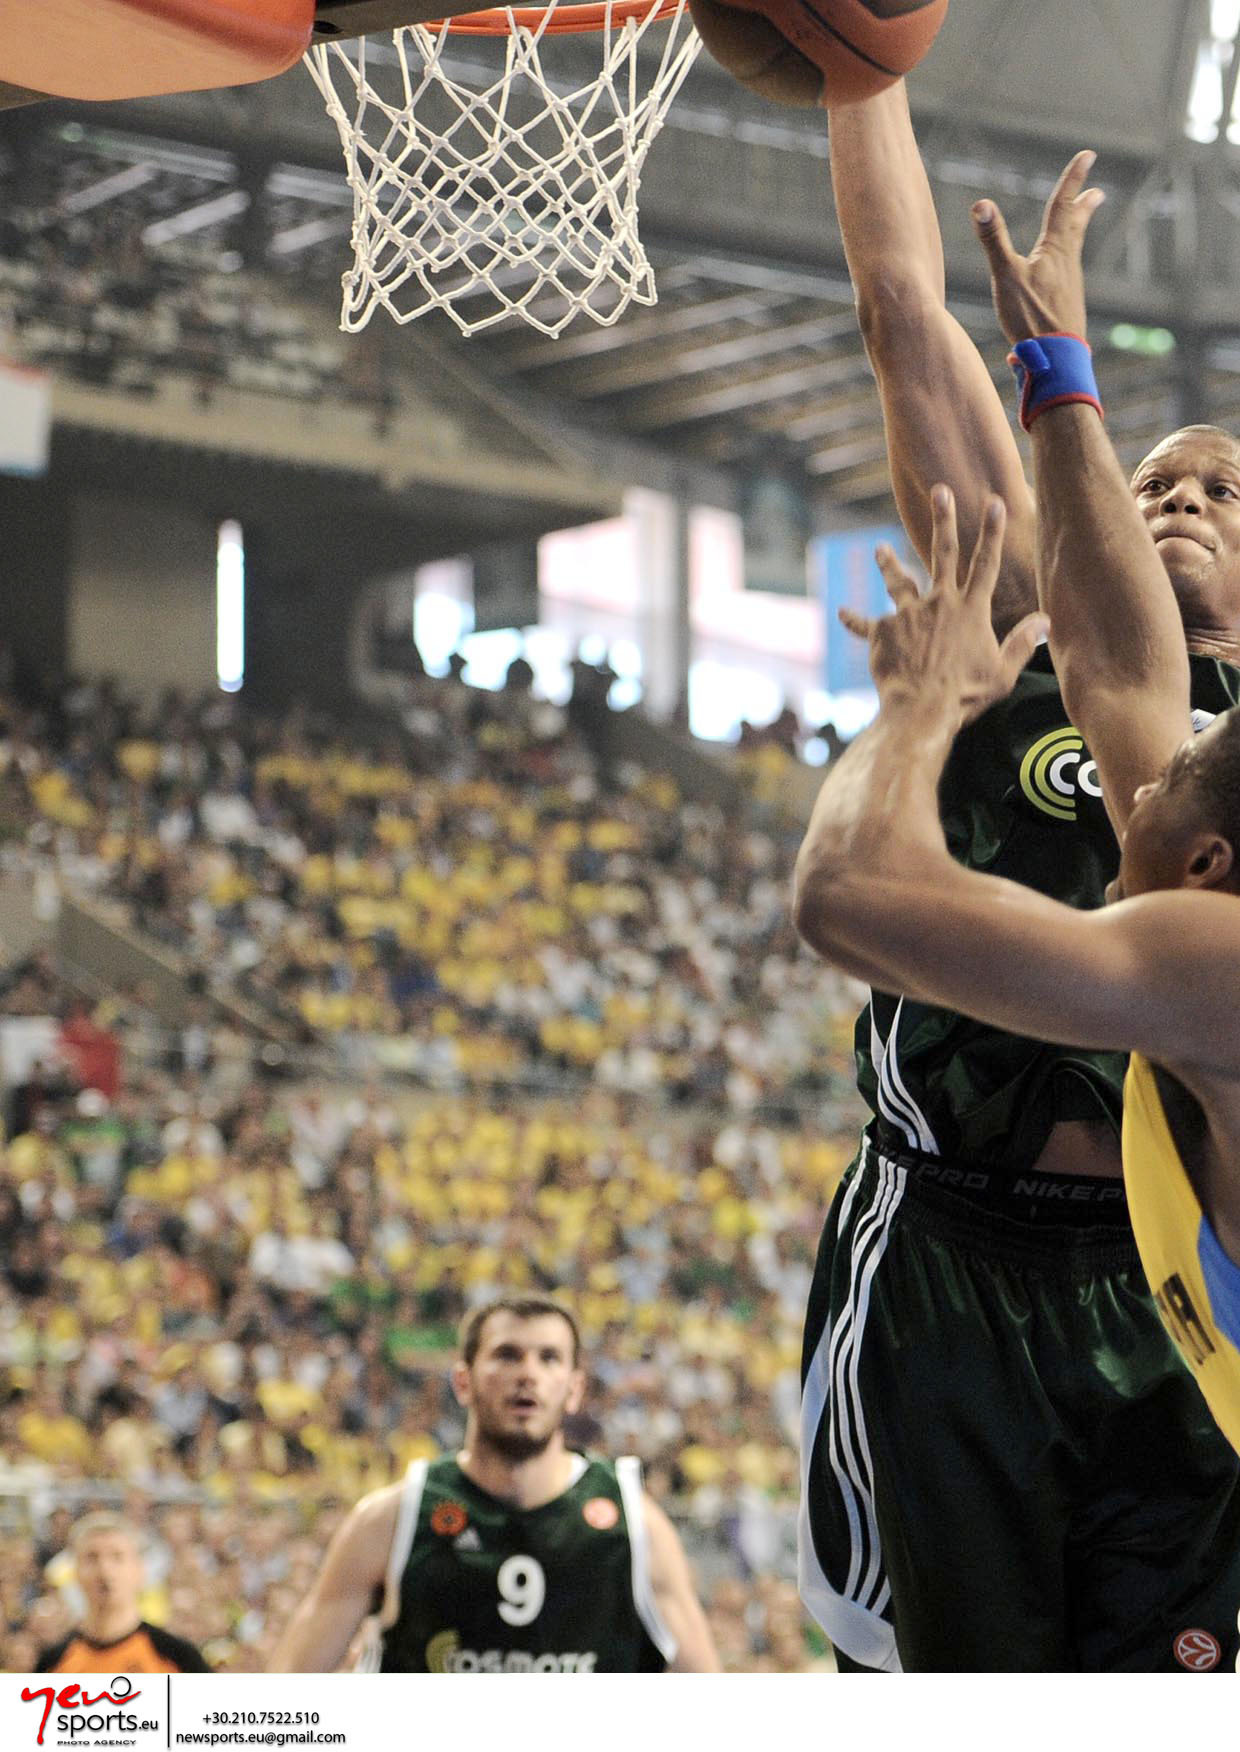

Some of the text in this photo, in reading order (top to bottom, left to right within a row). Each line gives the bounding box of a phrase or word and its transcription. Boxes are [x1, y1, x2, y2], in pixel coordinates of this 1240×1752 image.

[913, 1163, 990, 1190] PRO
[1013, 1178, 1095, 1201] NIKE
[497, 1554, 546, 1627] 9
